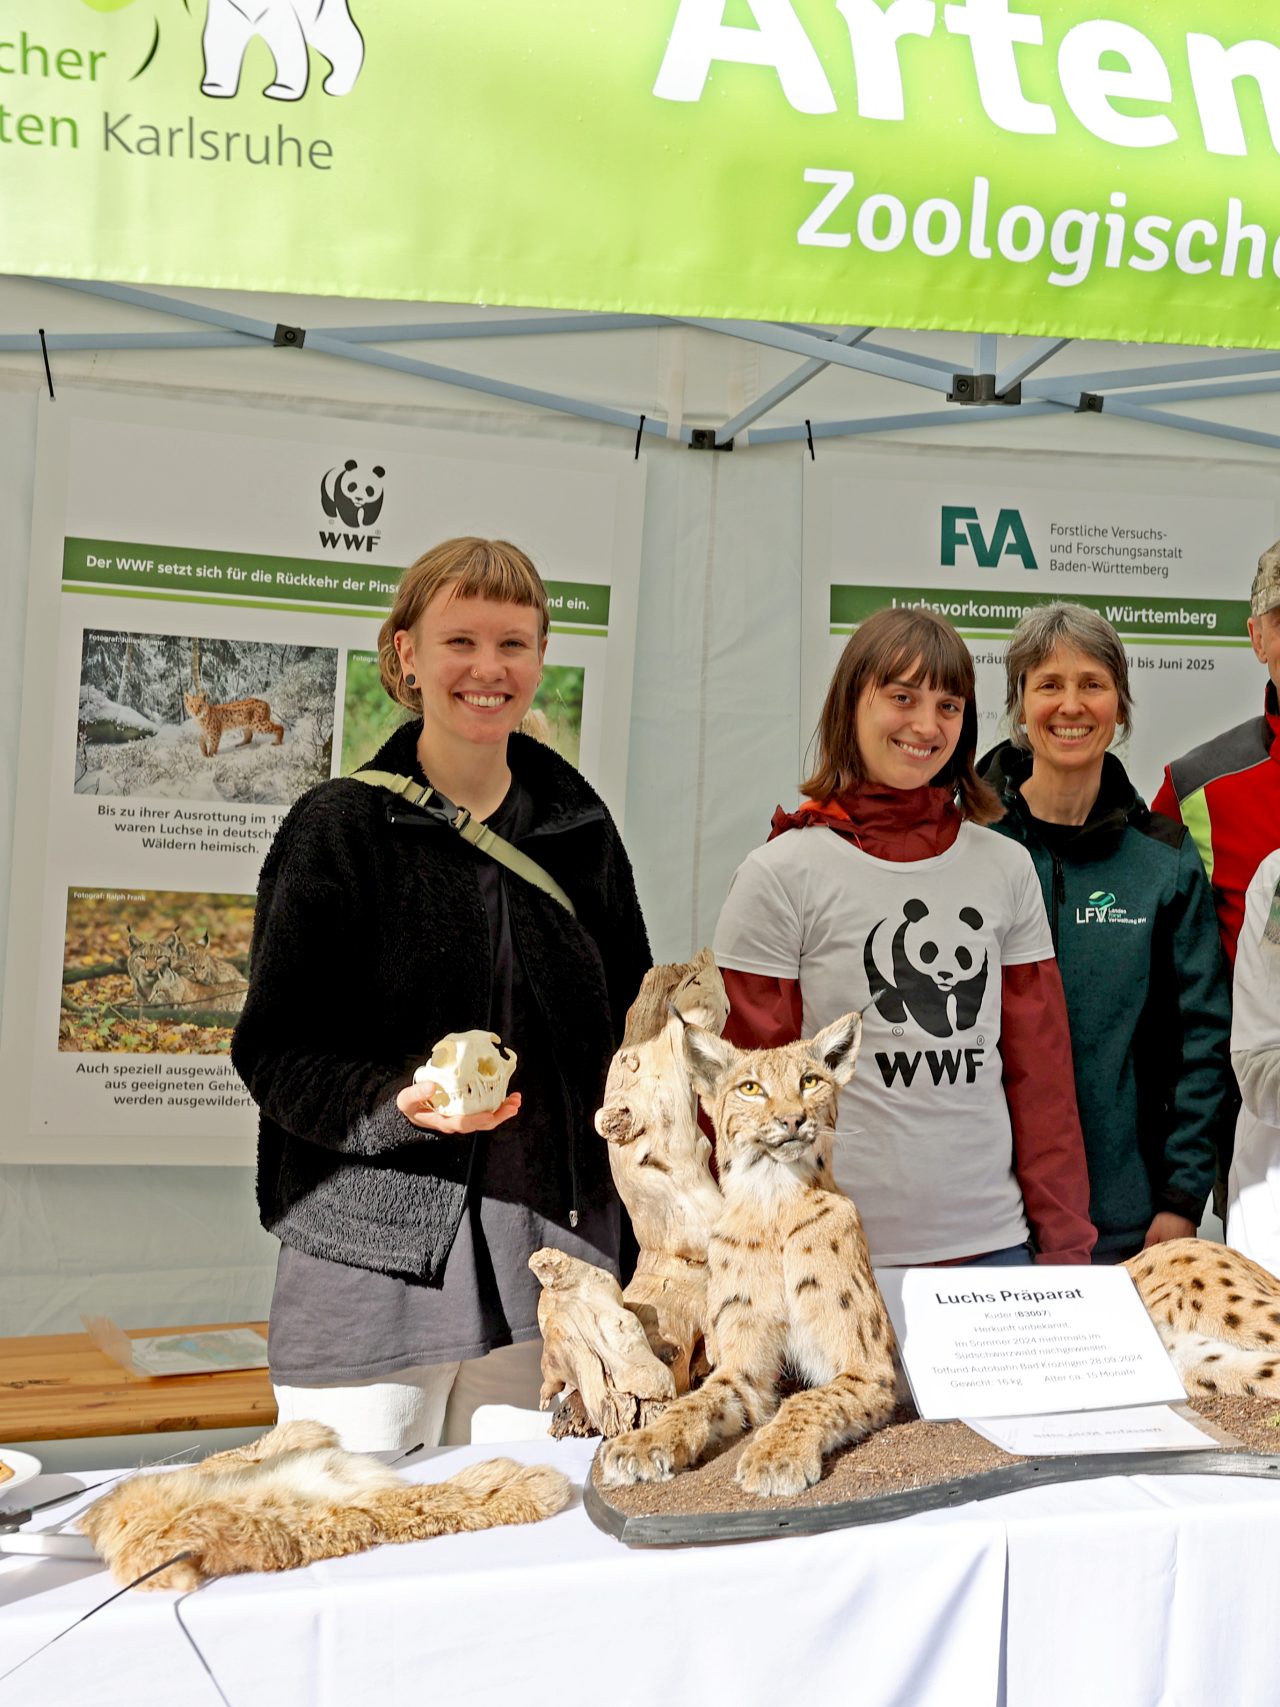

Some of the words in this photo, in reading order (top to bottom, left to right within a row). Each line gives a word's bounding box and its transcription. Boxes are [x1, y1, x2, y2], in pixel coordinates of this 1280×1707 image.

[0, 32, 107, 83] cher
[0, 113, 79, 149] ten
[102, 111, 333, 170] Karlsruhe
[940, 505, 1038, 569] FVA
[1050, 523, 1108, 538] Forstliche
[1111, 526, 1168, 540] Versuchs-
[318, 531, 381, 552] WWF
[1050, 542, 1072, 554] und
[1077, 542, 1183, 559] Forschungsanstalt
[86, 555, 112, 569] Der
[116, 557, 154, 573] WWF
[157, 562, 192, 577] setzt
[195, 565, 222, 579] sich
[226, 567, 247, 582] für
[250, 568, 272, 583] die
[276, 571, 340, 590] Rückkehr
[342, 576, 365, 591] der
[1049, 559, 1169, 579] Baden-Württemberg
[566, 597, 590, 611] ein.
[892, 598, 1032, 619] Luchsvorkomme
[1105, 606, 1217, 629] Württemberg
[352, 654, 379, 664] Fotogra
[1137, 657, 1155, 669] bis
[1158, 658, 1182, 670] Juni
[1186, 659, 1215, 670] 2025
[98, 804, 116, 817] Bis
[120, 807, 136, 818] zu
[139, 806, 170, 819] ihrer
[173, 808, 247, 826] Ausrottung
[250, 812, 266, 825] im
[114, 822, 156, 834] waren
[160, 822, 203, 836] Luchse
[207, 824, 219, 837] in
[223, 826, 276, 840] deutsche
[141, 837, 197, 851] Wäldern
[200, 841, 260, 854] heimisch.
[1076, 906, 1108, 924] LFV
[76, 1062, 109, 1075] Auch
[113, 1063, 162, 1079] speziell
[166, 1065, 235, 1080] ausgewähl
[874, 1049, 984, 1088] WWF
[104, 1079, 127, 1090] aus
[131, 1080, 204, 1093] geeigneten
[208, 1080, 248, 1094] Geheg
[114, 1093, 163, 1106] werden
[167, 1095, 254, 1109] ausgewildert.
[935, 1291, 996, 1305] Luchs
[1000, 1287, 1085, 1304] Präparat
